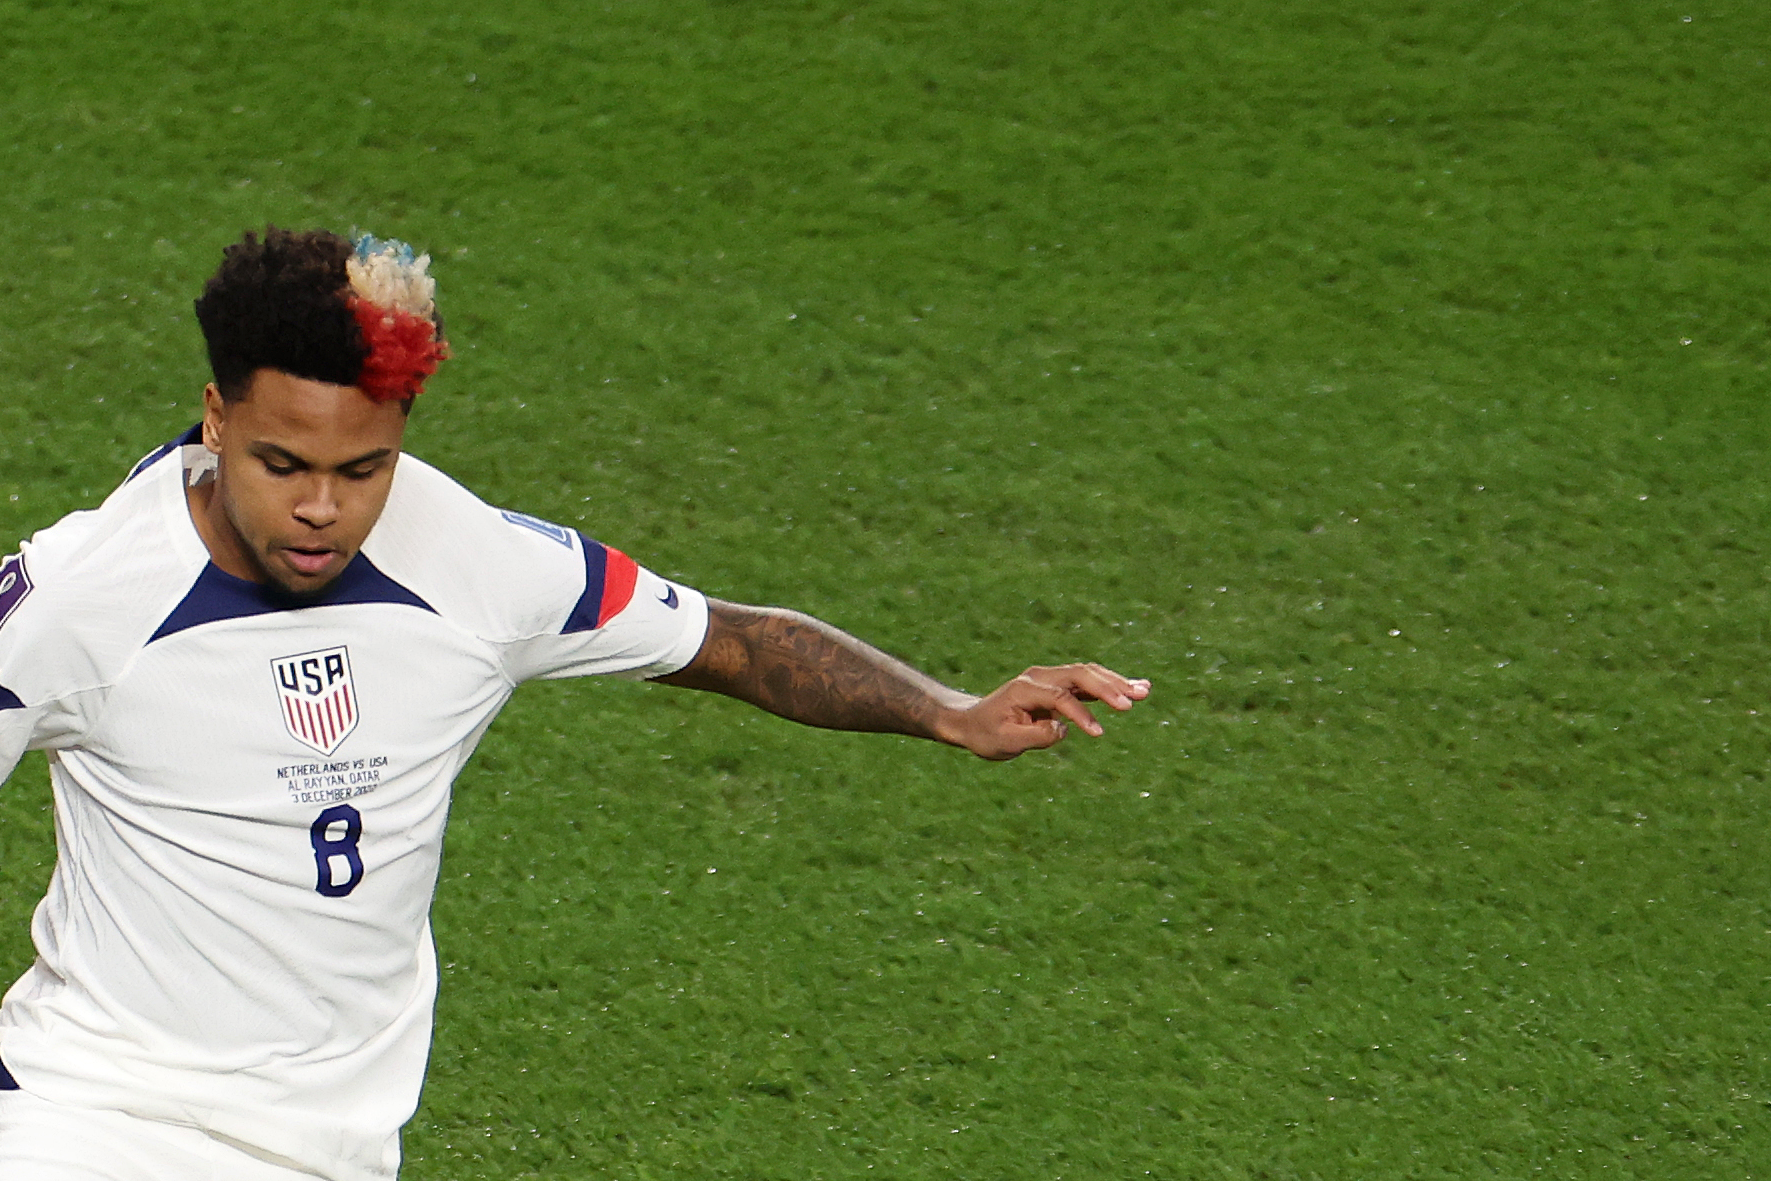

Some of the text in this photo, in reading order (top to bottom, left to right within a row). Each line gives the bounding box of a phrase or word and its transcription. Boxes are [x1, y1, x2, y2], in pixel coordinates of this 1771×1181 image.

[278, 653, 346, 697] USA
[277, 756, 388, 779] NETHERLANDS VS USA
[288, 780, 301, 792] AL
[349, 770, 380, 784] QATAR
[301, 787, 352, 803] DECEMBER
[310, 803, 364, 898] 8
